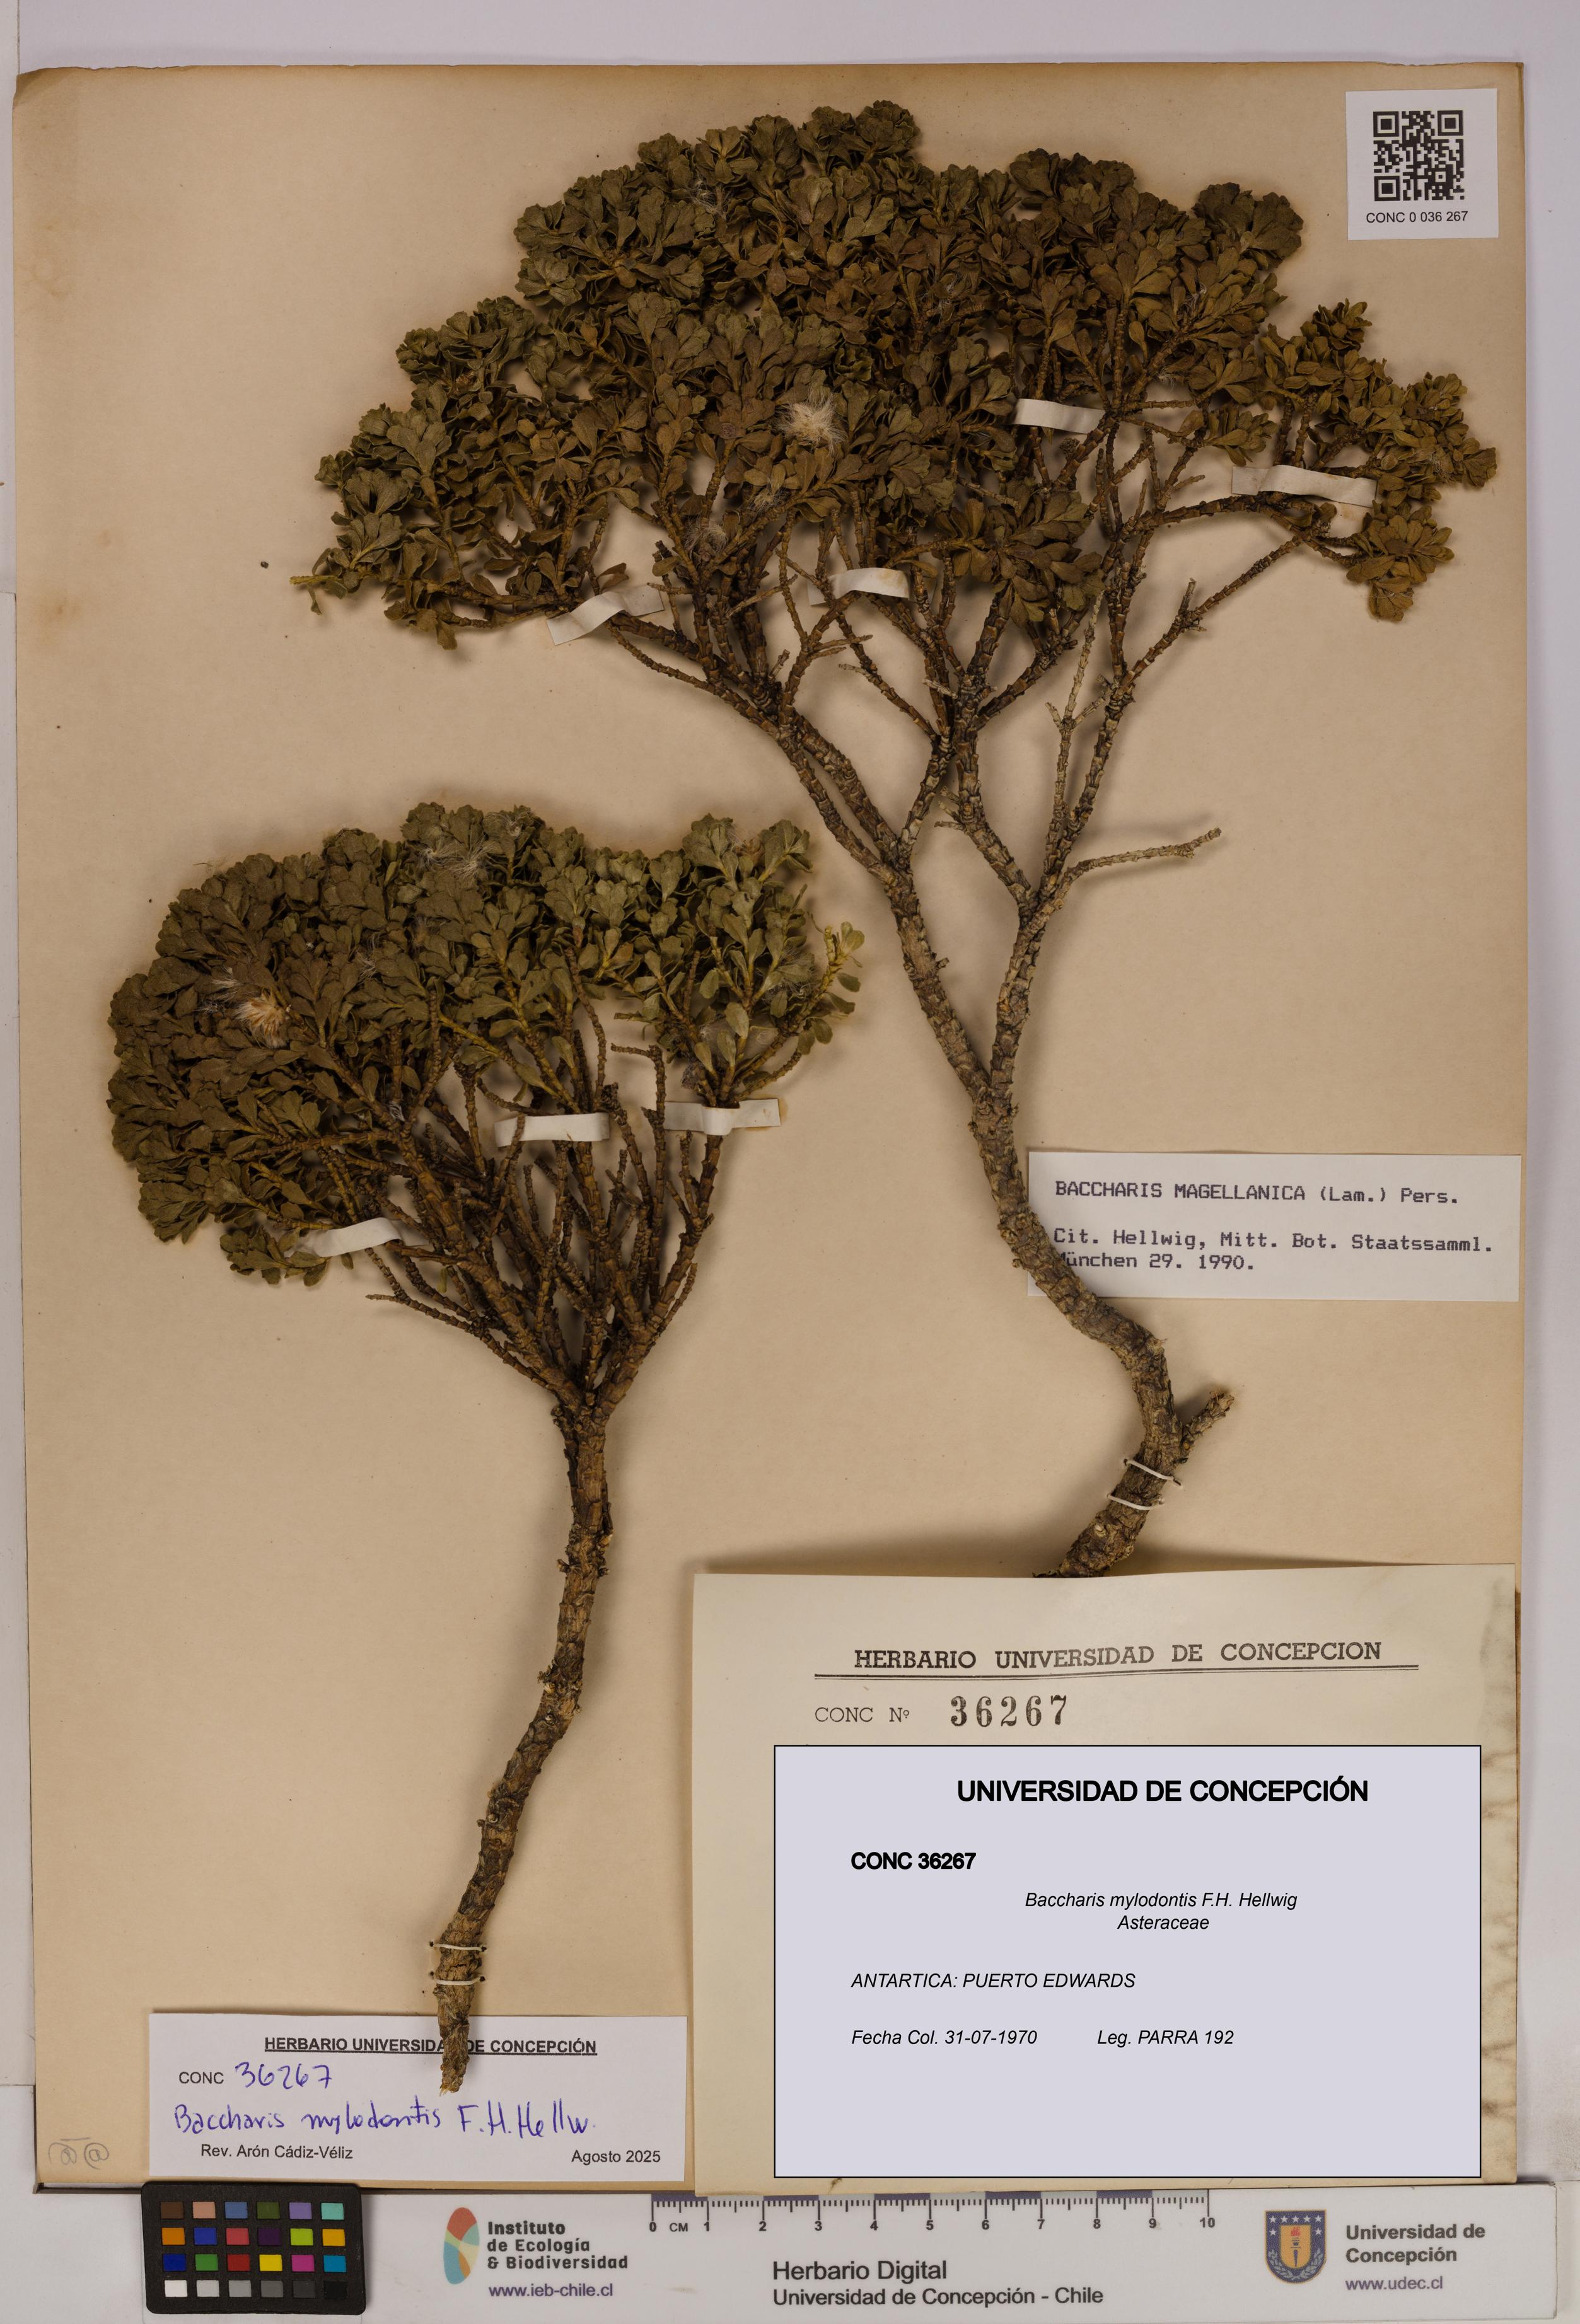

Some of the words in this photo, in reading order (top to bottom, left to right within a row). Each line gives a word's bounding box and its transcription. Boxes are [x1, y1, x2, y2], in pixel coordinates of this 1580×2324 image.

[1366, 212, 1405, 223] CONC
[1409, 212, 1417, 223] 0
[1420, 211, 1443, 223] 036
[1446, 211, 1468, 222] 267
[1055, 1181, 1163, 1198] BACCHARIS
[1174, 1183, 1305, 1201] MAGELLANICA
[1320, 1186, 1386, 1203] (Lam.)
[1400, 1187, 1458, 1204] Pers.
[1054, 1227, 1099, 1244] Cit.
[1113, 1229, 1205, 1251] Hellwig,
[1220, 1231, 1277, 1247] Mitt.
[1291, 1232, 1337, 1249] Bot.
[1351, 1234, 1492, 1252] Staatssamml.
[1149, 1253, 1182, 1269] 29.
[1199, 1254, 1253, 1270] 1990.
[854, 1650, 977, 1669] HERBARIO
[994, 1646, 1155, 1670] UNIVERSIDAD
[1171, 1643, 1203, 1662] DE
[1221, 1641, 1382, 1662] CONCEPCION
[815, 1707, 873, 1723] CONC
[950, 1694, 1067, 1728] 36267
[265, 2037, 347, 2050] HERBARIO
[353, 2038, 446, 2052] UNIVERSIDA
[491, 2037, 598, 2053] CONCEPCIÓN
[178, 2071, 224, 2084] CONC
[235, 2062, 332, 2090] 36267
[201, 2143, 232, 2157] Rev.
[236, 2144, 269, 2158] Arón
[274, 2145, 353, 2159] Cádiz-Véliz
[571, 2149, 621, 2166] Agosto
[625, 2149, 661, 2163] 2025
[488, 2220, 566, 2235] Instituto
[649, 2221, 657, 2233] 0
[669, 2223, 688, 2233] CM
[703, 2221, 710, 2232] 1
[758, 2221, 767, 2232] 2
[814, 2220, 823, 2231] 3
[869, 2220, 878, 2231] 4
[926, 2219, 934, 2231] 5
[981, 2219, 990, 2230] 6
[1037, 2218, 1045, 2229] 7
[1093, 2218, 1101, 2229] 8
[1148, 2217, 1158, 2229] 9
[1199, 2217, 1216, 2228] 10
[1346, 2223, 1457, 2240] Universidad
[1462, 2223, 1486, 2239] de
[487, 2238, 508, 2252] de
[515, 2238, 590, 2255] Ecología
[487, 2256, 499, 2270] &
[506, 2255, 628, 2270] Biodiversidad
[1345, 2246, 1457, 2266] Concepción
[773, 2260, 870, 2281] Herbario
[877, 2260, 948, 2284] Digital
[488, 2282, 613, 2297] www.ieb-chile.cl
[1345, 2275, 1443, 2291] www.udec.cl
[774, 2288, 886, 2306] Universidad
[892, 2288, 916, 2305] de
[922, 2287, 1035, 2308] Concepción
[1055, 2287, 1104, 2304] Chile
